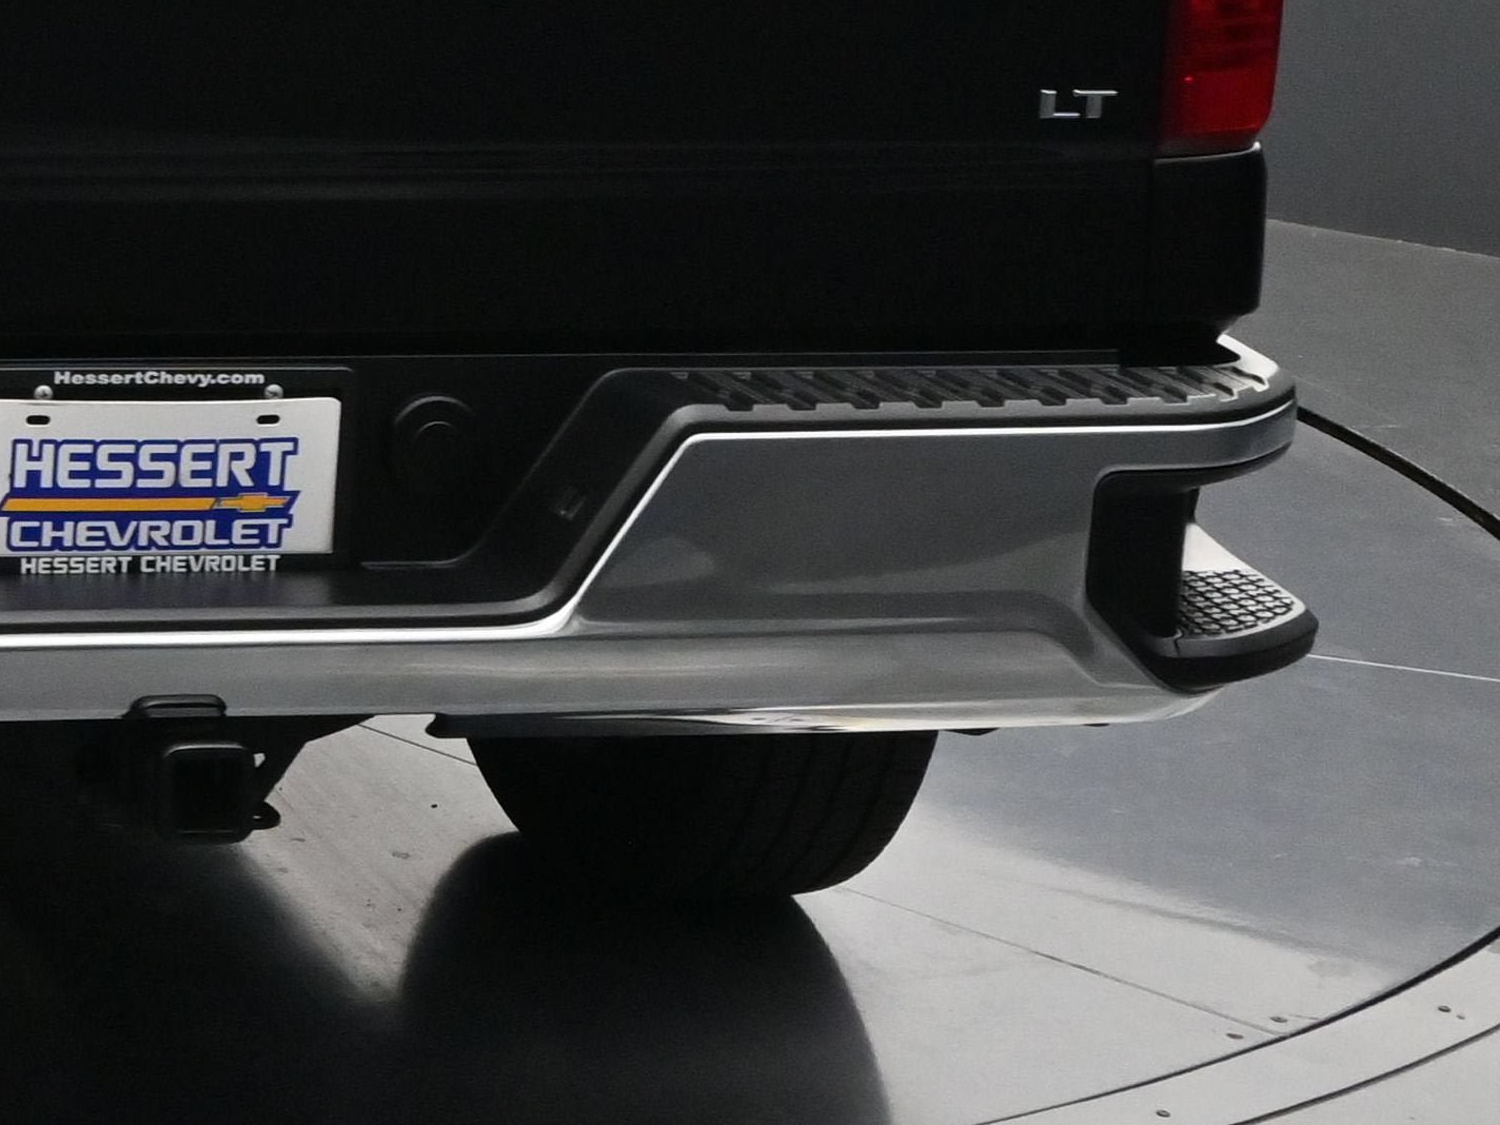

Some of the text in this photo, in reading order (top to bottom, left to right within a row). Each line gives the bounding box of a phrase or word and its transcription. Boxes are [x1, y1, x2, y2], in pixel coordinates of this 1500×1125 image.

[1038, 88, 1119, 120] LT
[53, 371, 266, 388] HessertChevy.com
[12, 440, 296, 490] HESSERT
[8, 518, 290, 549] CHEVROLET
[20, 554, 281, 575] HESSERT CHEVROLET
